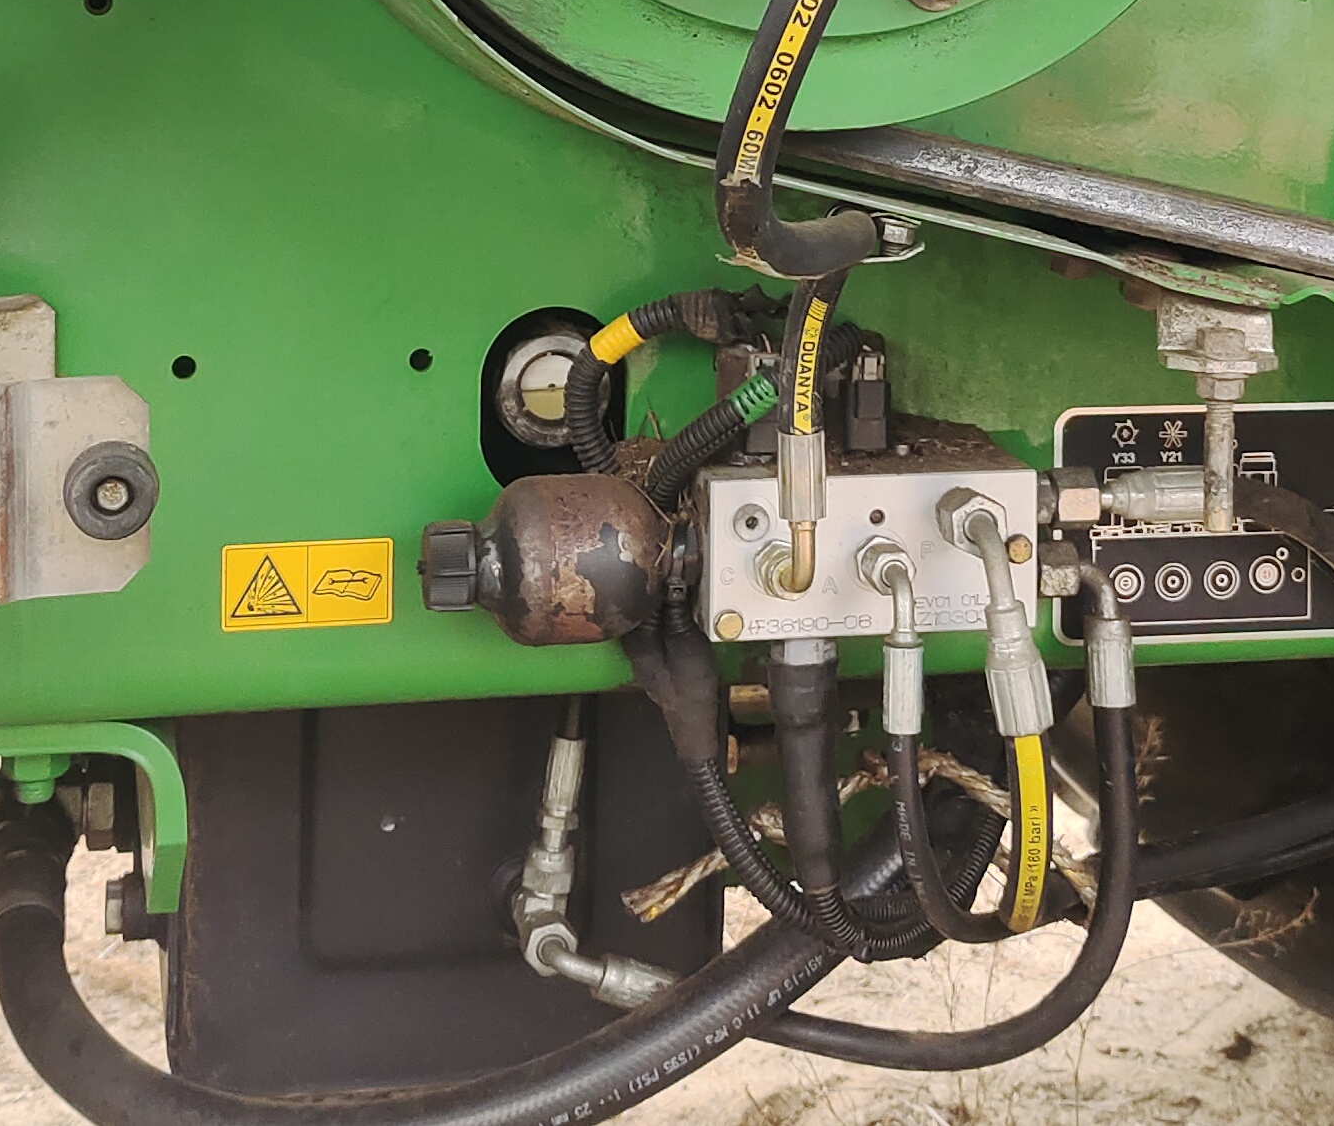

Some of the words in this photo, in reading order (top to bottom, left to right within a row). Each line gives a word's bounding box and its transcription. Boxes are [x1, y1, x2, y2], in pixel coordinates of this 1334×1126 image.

[757, 51, 795, 111] 0602
[796, 341, 816, 414] DUANYA
[1112, 451, 1136, 465] Y33
[1159, 450, 1183, 463] Y21
[719, 567, 734, 586] C
[821, 575, 838, 595] A
[914, 595, 951, 609] EV01
[961, 593, 990, 607] 01L
